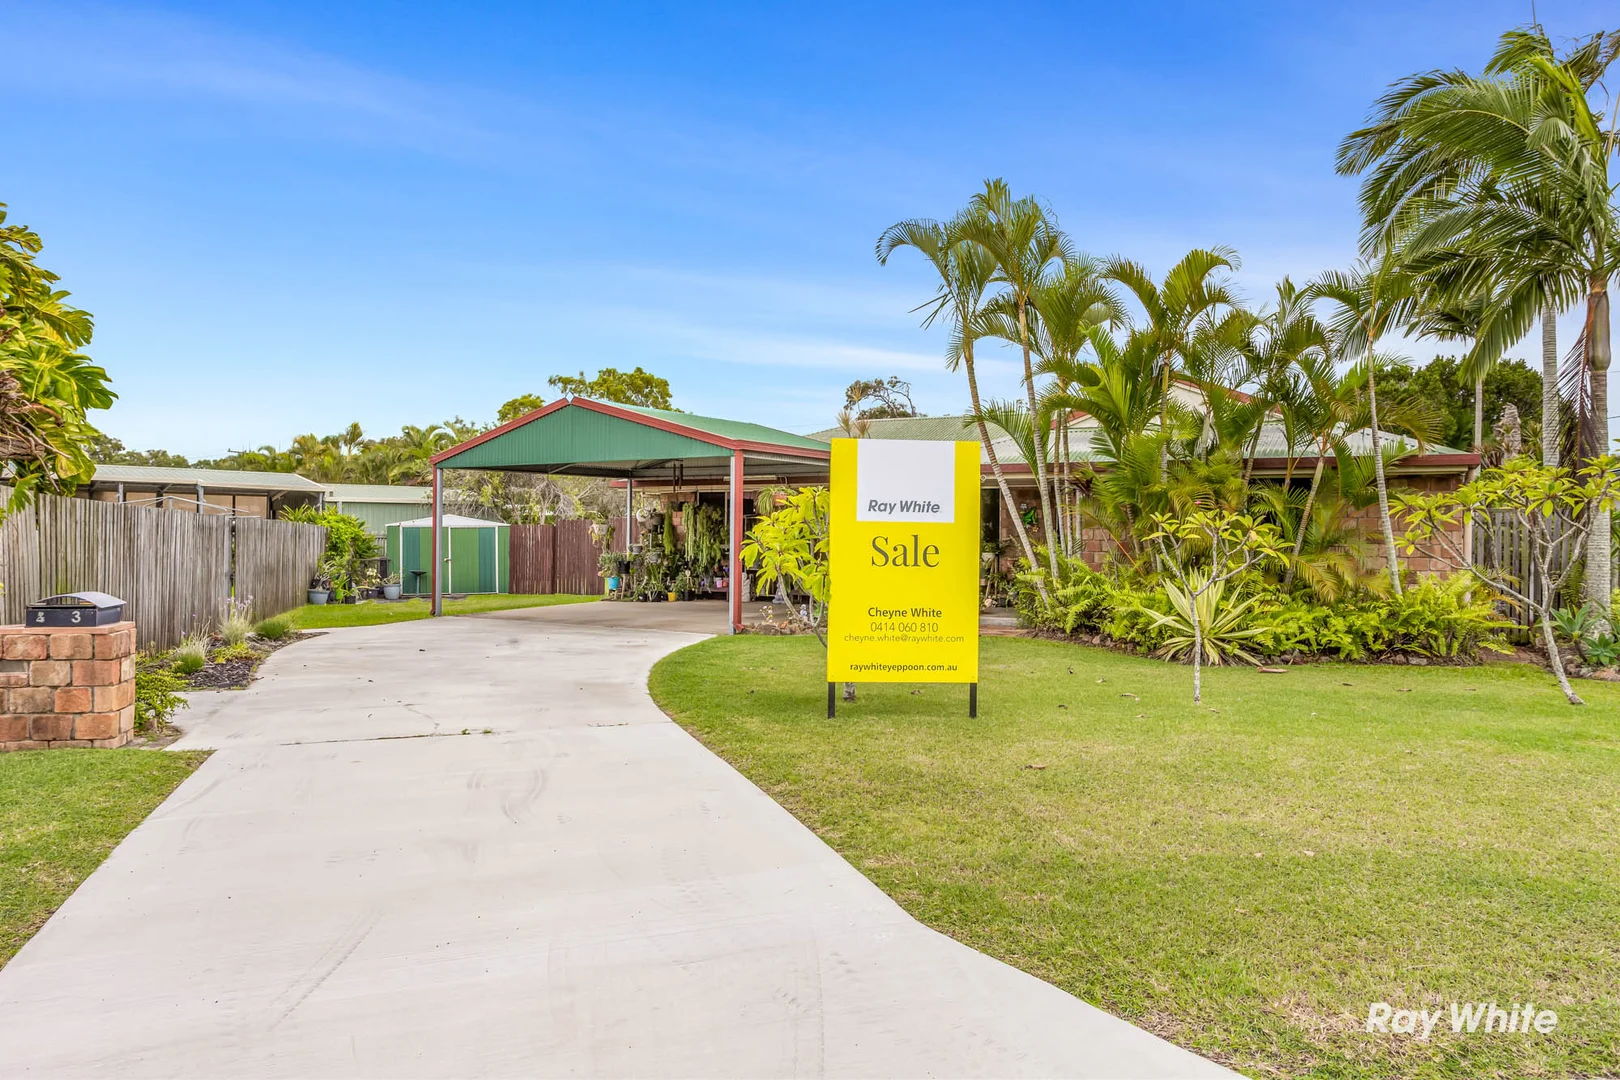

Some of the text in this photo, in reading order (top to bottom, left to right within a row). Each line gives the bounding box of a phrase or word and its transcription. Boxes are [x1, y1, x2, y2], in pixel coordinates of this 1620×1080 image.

[868, 499, 940, 514] Ray White
[871, 534, 939, 568] Sale
[71, 610, 80, 623] 3
[868, 607, 942, 619] Cheyne White
[870, 622, 938, 632] 0414 060 810
[844, 633, 964, 644] cheyne.white@raywhite.com
[850, 663, 958, 672] raywhiteyeppoon.com.au
